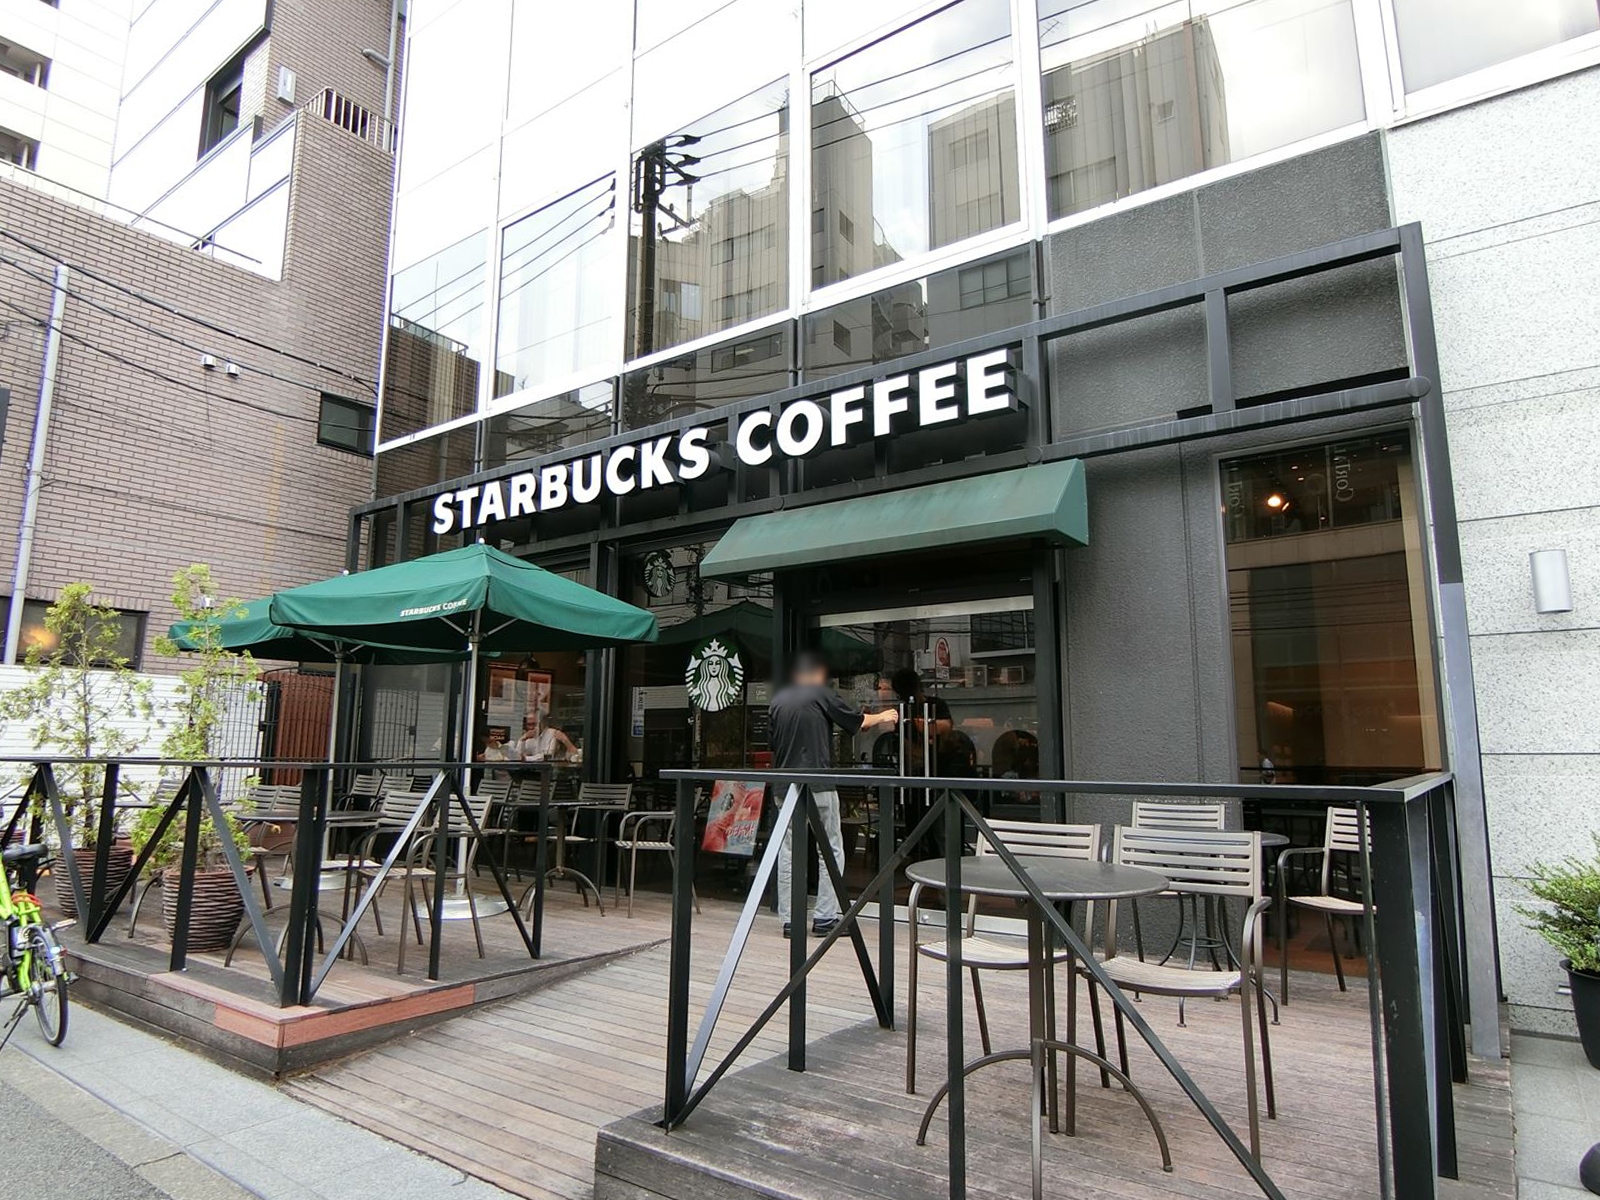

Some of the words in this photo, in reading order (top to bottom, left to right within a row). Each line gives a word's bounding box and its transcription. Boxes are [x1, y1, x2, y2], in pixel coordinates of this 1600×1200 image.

[432, 428, 711, 535] STARBUCKS
[735, 349, 1010, 466] COFFEE
[400, 604, 441, 617] STARBUCKS
